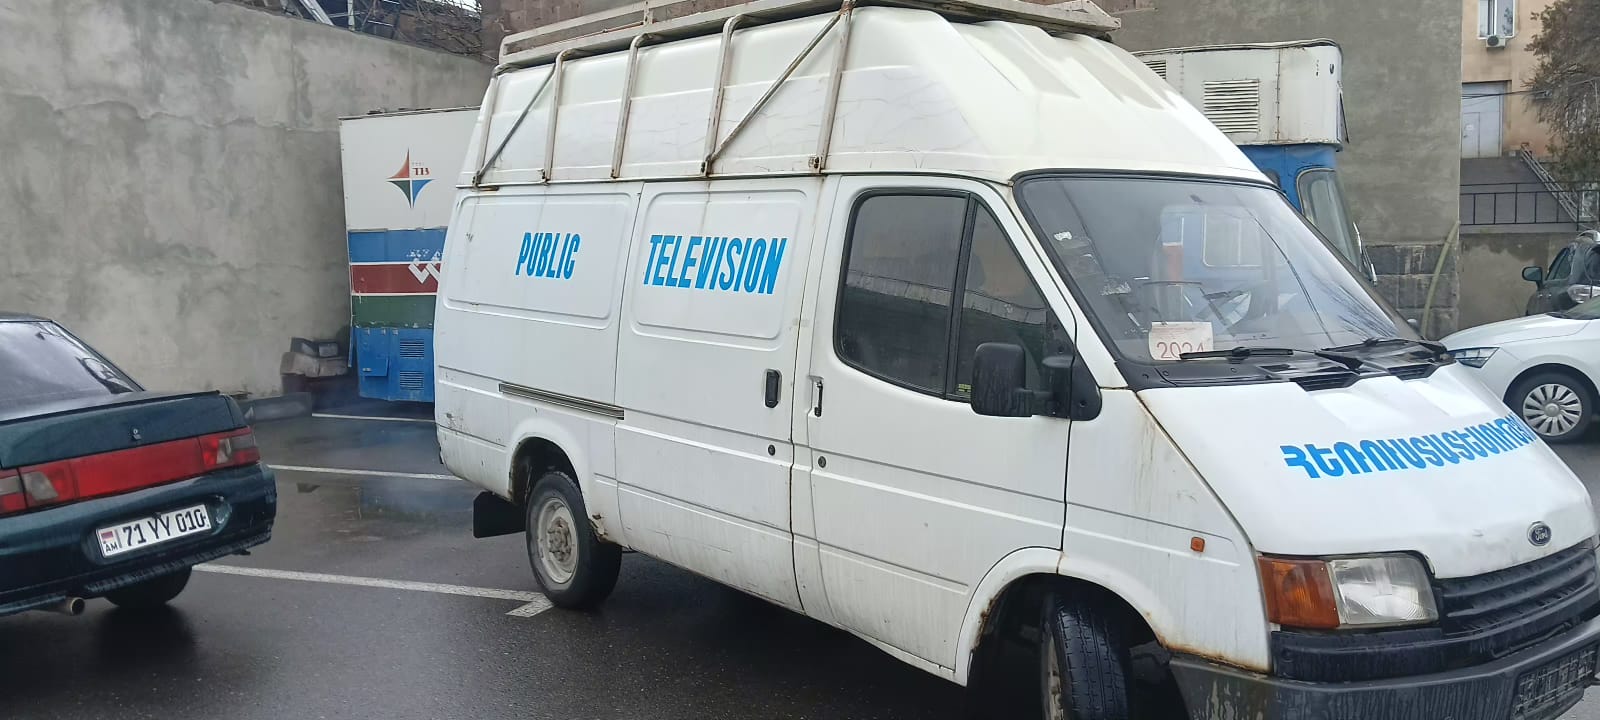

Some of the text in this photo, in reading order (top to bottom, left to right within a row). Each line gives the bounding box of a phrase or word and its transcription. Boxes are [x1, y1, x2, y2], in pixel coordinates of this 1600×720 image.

[515, 232, 787, 295] PUBLIC TELEVISION
[105, 541, 118, 553] AM
[122, 508, 206, 547] 71 YY 010
